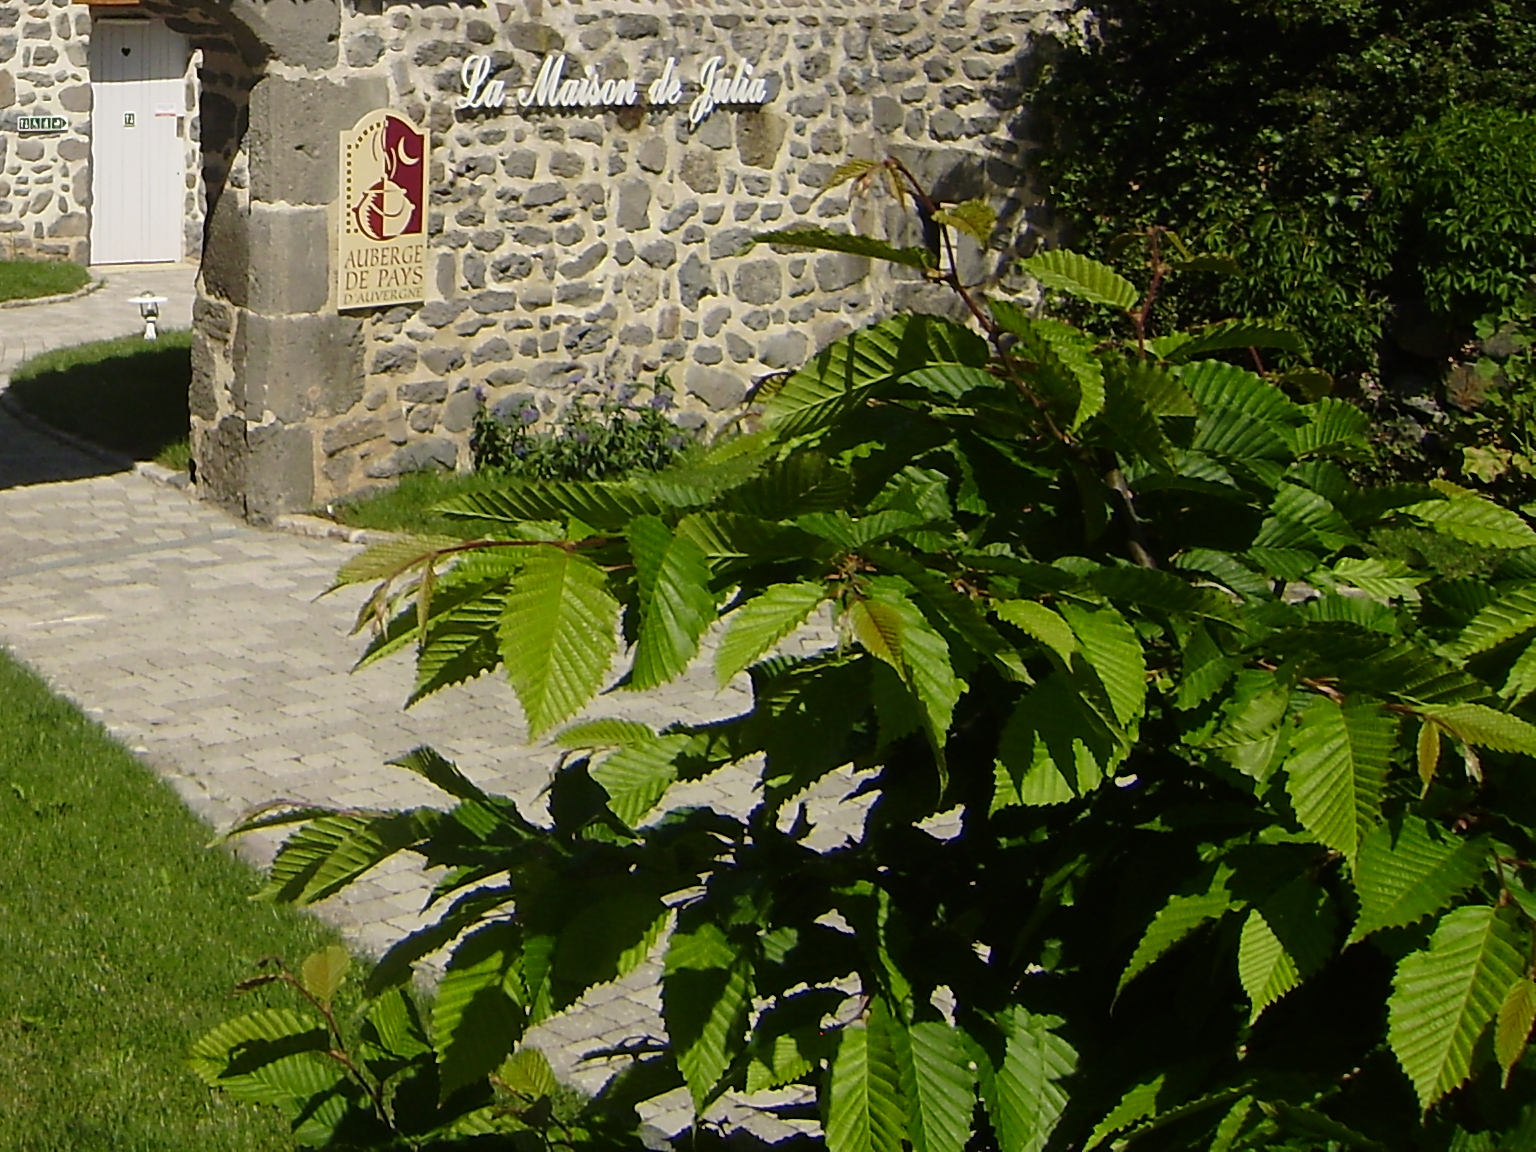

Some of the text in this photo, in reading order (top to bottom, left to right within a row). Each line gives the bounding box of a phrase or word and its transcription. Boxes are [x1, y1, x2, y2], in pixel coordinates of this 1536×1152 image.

[457, 54, 767, 125] La Maison de Julia
[344, 244, 423, 269] AUBERGE
[346, 266, 423, 290] DE PAYS
[344, 286, 423, 305] D'AUVERGNE
